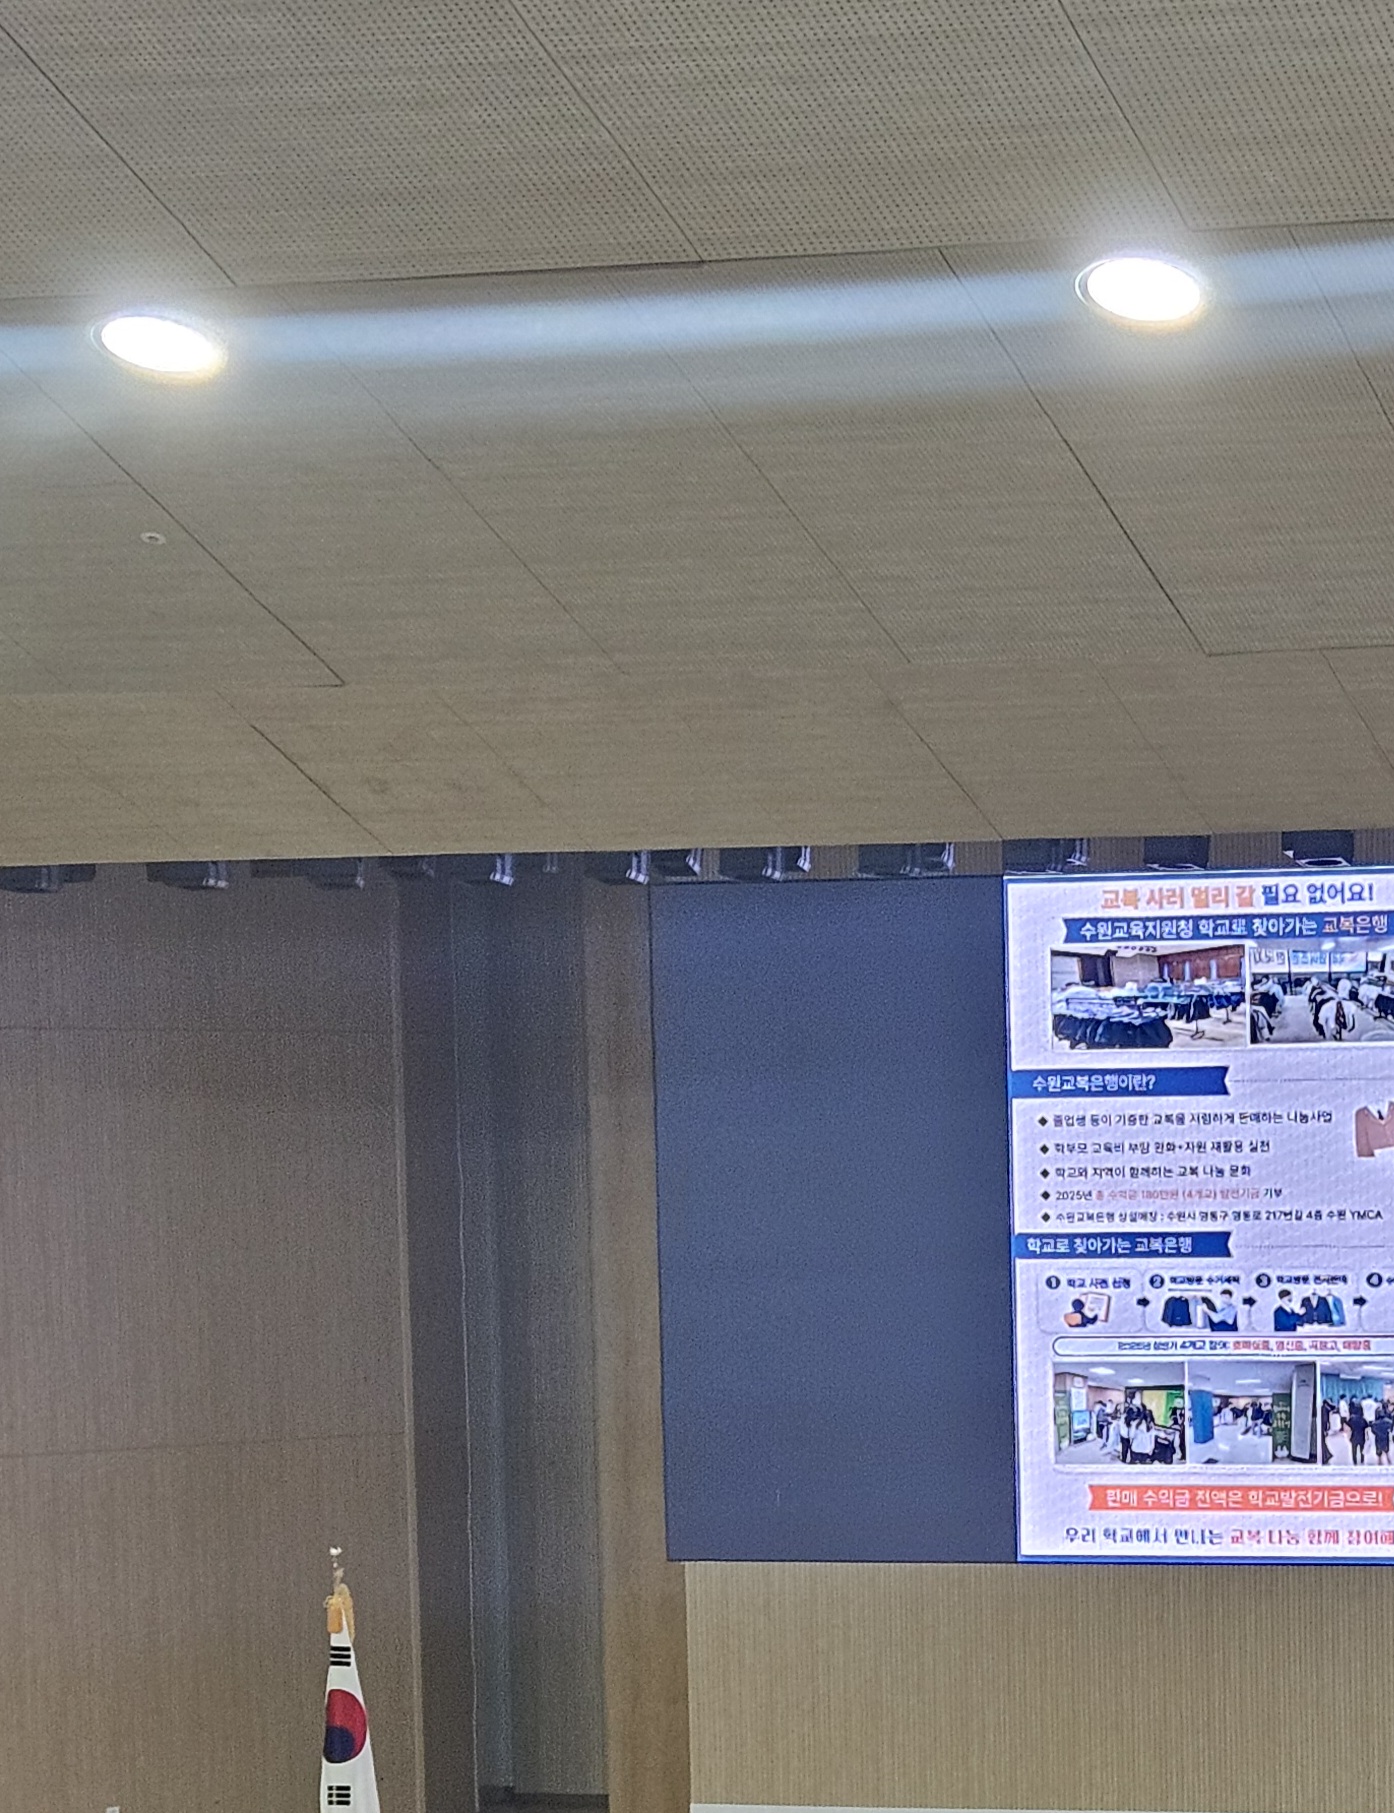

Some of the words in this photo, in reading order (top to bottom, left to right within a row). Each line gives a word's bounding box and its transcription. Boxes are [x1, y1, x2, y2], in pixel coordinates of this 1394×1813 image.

[1101, 888, 1140, 909] 교복
[1145, 886, 1185, 909] 사러
[1191, 885, 1229, 909] 멀리
[1236, 884, 1255, 907] 갈
[1261, 883, 1301, 906] 필요
[1306, 881, 1374, 905] 없어요!
[1080, 918, 1194, 941] 수원교육지원청
[1198, 918, 1248, 938] 학교로
[1252, 916, 1318, 937] 찾아가는
[1322, 914, 1388, 935] 교복은행
[1032, 1073, 1156, 1093] 수원교복은행이란?
[1350, 1209, 1384, 1221] YMCA
[1027, 1237, 1070, 1254] 학교로
[1073, 1237, 1131, 1254] 찾아가는
[1134, 1236, 1192, 1254] 교복은행
[1106, 1489, 1138, 1507] 판매
[1143, 1489, 1190, 1507] 수익금
[1195, 1489, 1243, 1507] 전액은
[1248, 1489, 1383, 1509] 학교발전기금으로!
